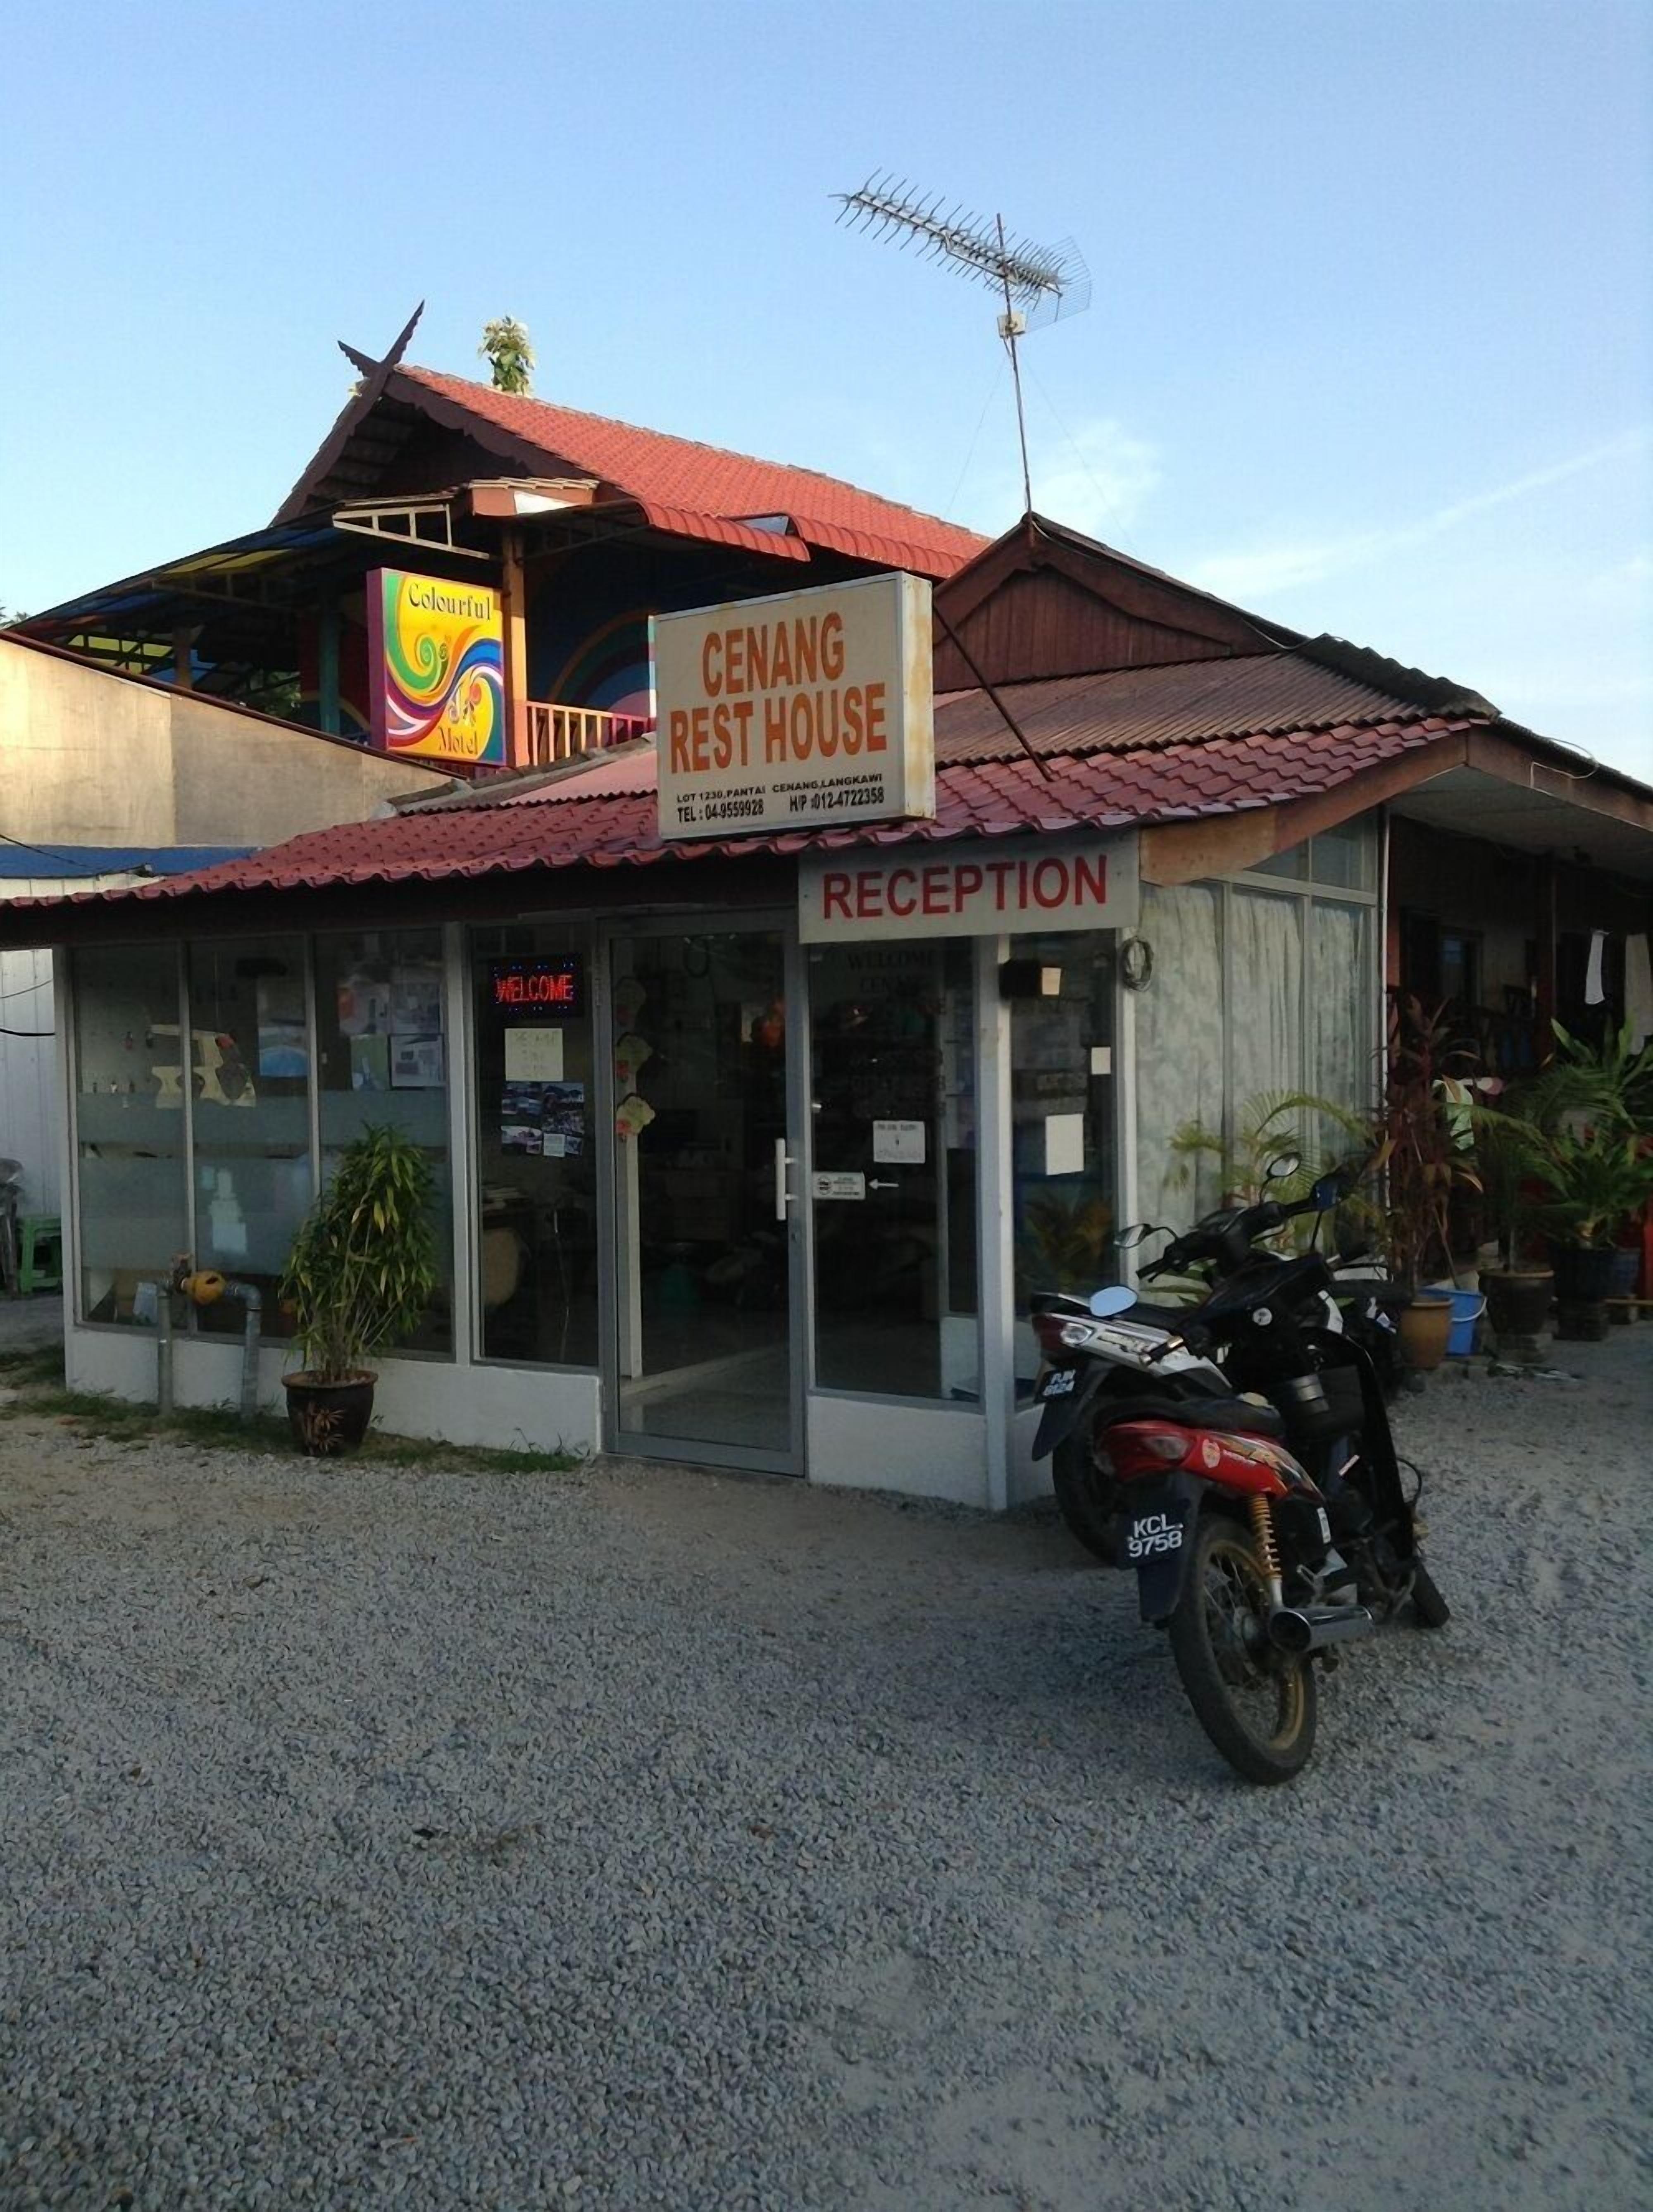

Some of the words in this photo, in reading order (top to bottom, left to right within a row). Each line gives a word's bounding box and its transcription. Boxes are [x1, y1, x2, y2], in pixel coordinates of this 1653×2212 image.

[409, 583, 491, 620] Colourful
[703, 612, 844, 697] CENANG
[438, 726, 478, 755] Motel
[670, 702, 753, 774] REST
[765, 682, 887, 763] HOUSE
[676, 794, 696, 803] LOT
[824, 854, 1108, 920] RECEPTION
[497, 975, 574, 1002] WELCOME
[1134, 1514, 1176, 1538] KCL
[1129, 1530, 1182, 1557] 9758
